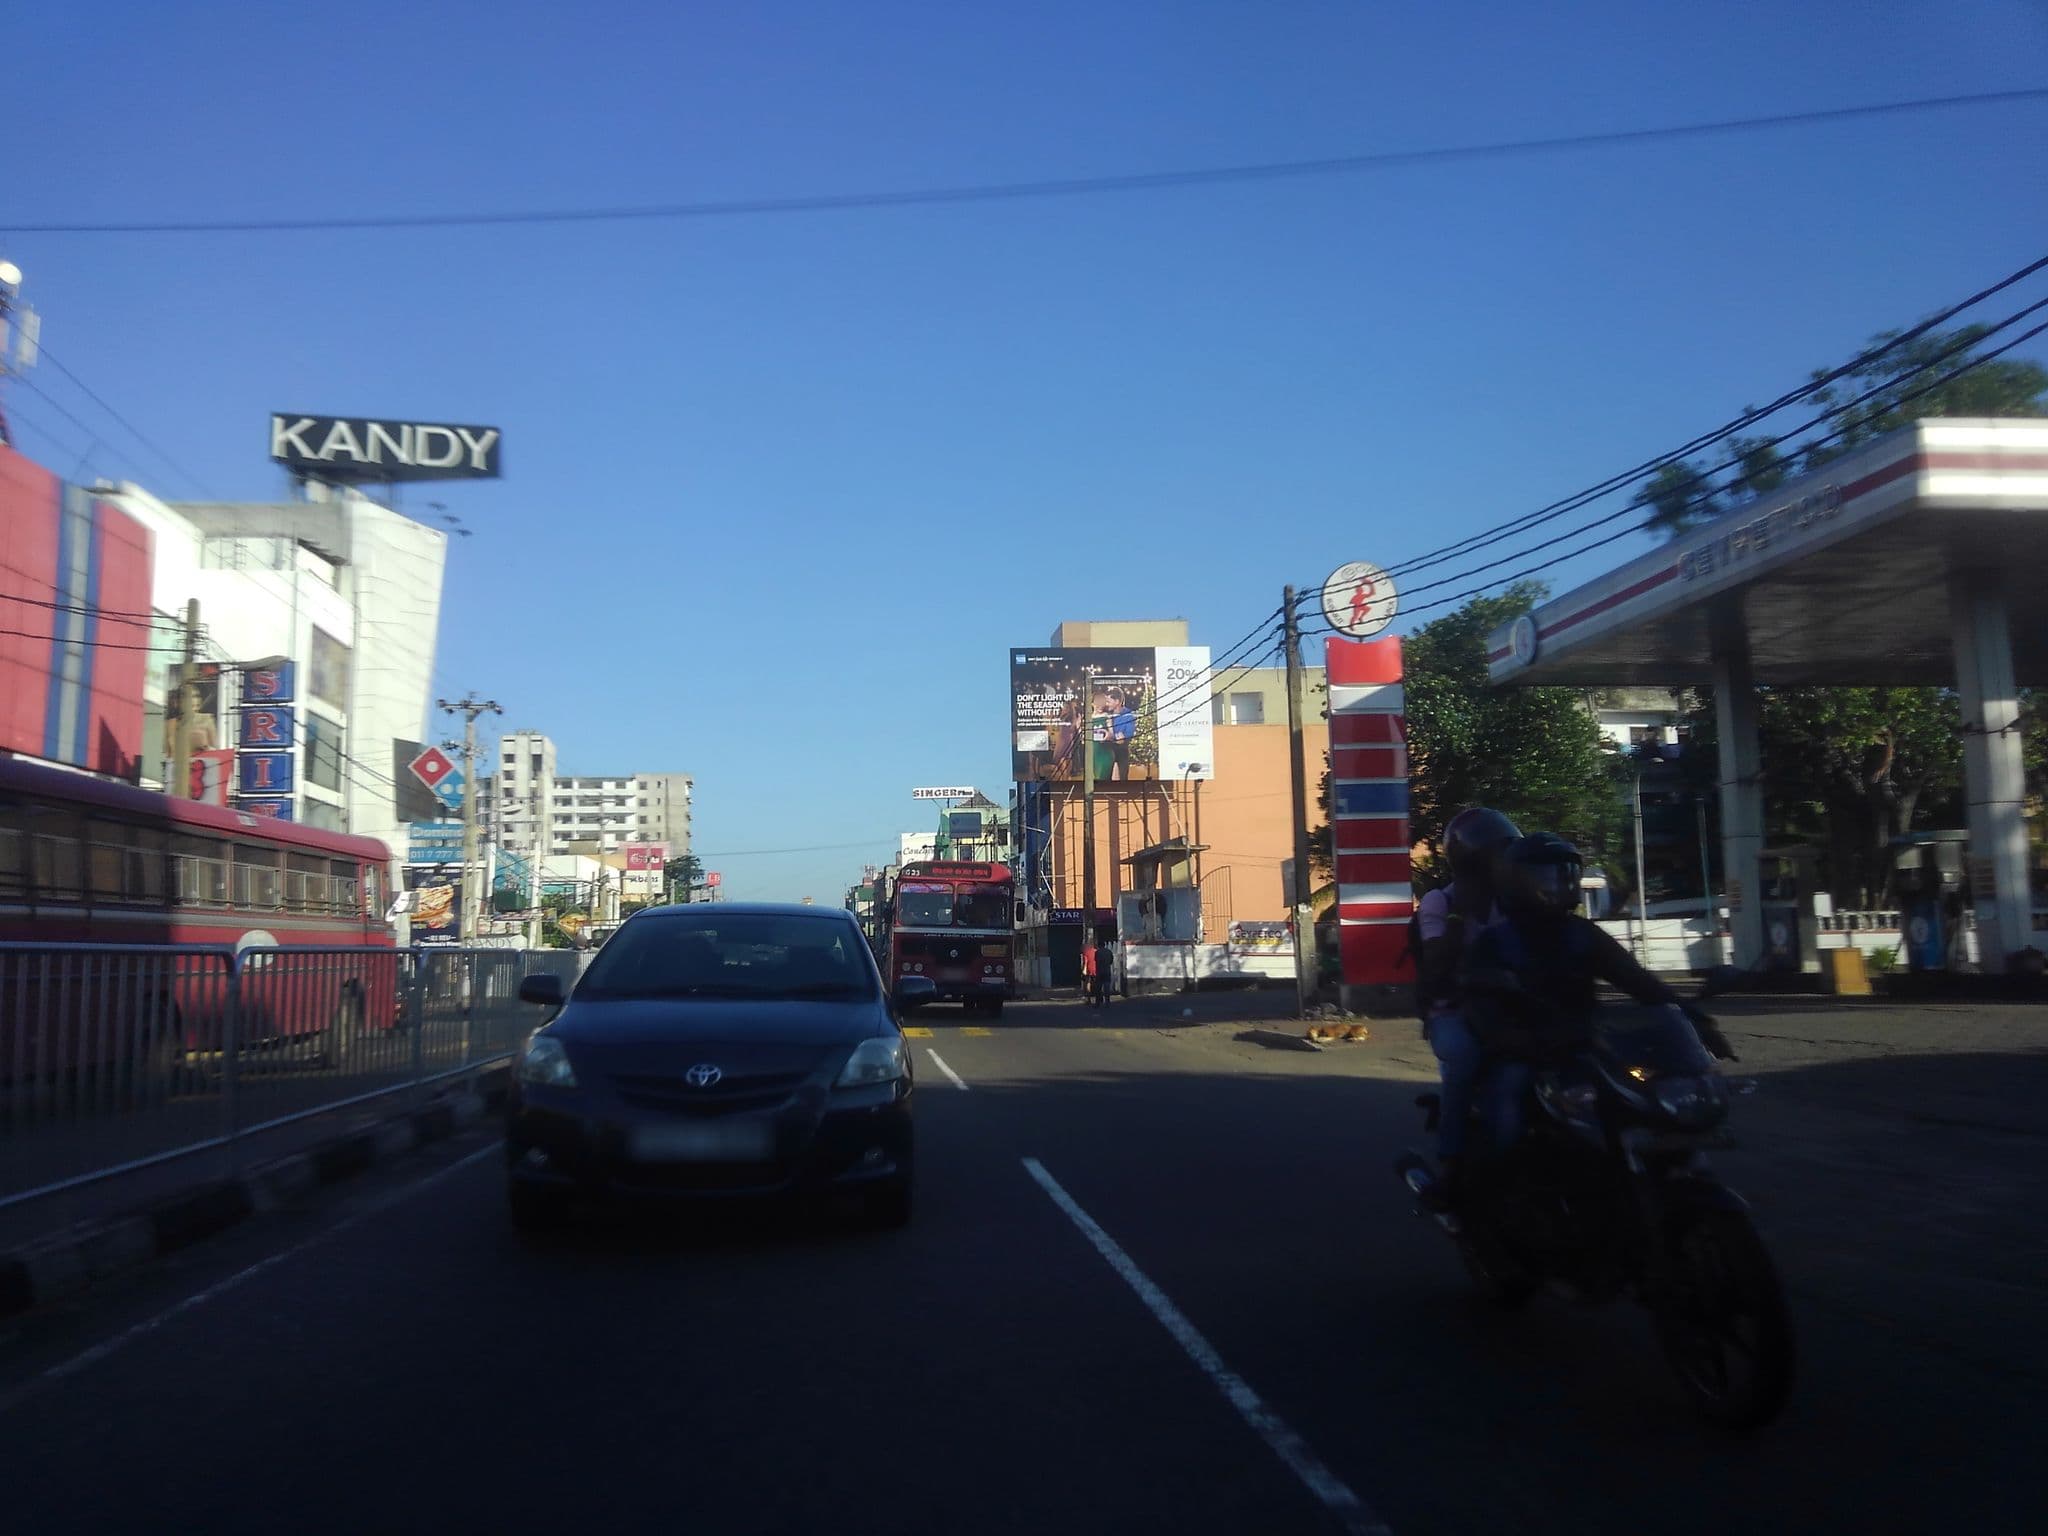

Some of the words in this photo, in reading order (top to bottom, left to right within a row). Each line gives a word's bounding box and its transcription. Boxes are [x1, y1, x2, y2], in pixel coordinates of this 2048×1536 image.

[271, 416, 499, 471] KANDY
[1172, 658, 1192, 667] Enjoy
[1167, 668, 1199, 680] 20%
[1017, 694, 1041, 702] DON'T
[1041, 694, 1063, 702] LIGHT
[1064, 693, 1074, 701] UP
[1017, 701, 1032, 709] THE
[1033, 701, 1064, 709] SEASON
[1017, 708, 1053, 716] WITHOUT
[1053, 708, 1060, 716] IT
[912, 788, 957, 798] SINGER
[1055, 911, 1080, 919] STAR
